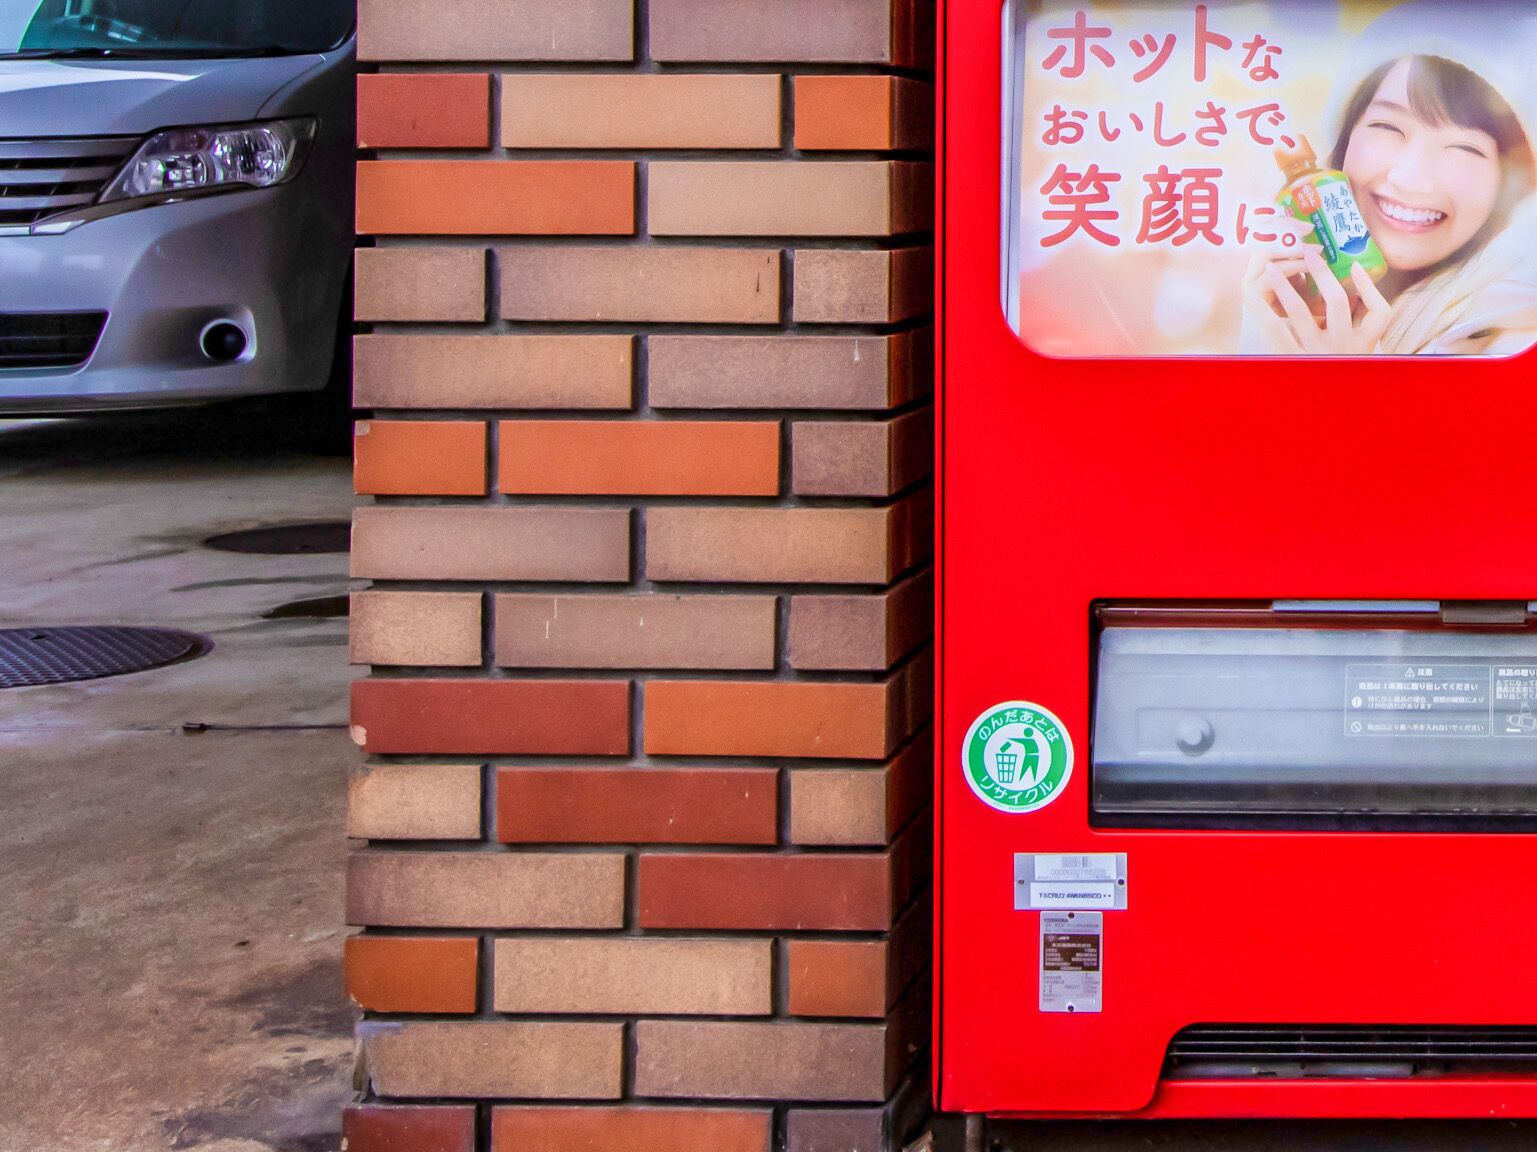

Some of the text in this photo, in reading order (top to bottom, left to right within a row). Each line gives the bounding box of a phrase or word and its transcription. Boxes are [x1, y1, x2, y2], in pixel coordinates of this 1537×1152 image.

[1042, 4, 1284, 83] ホットな
[1042, 100, 1297, 149] おいしさで、
[1040, 162, 1297, 248] 笑顔に。
[978, 709, 1060, 742] のんだあとは
[980, 775, 1054, 805] リサイクル
